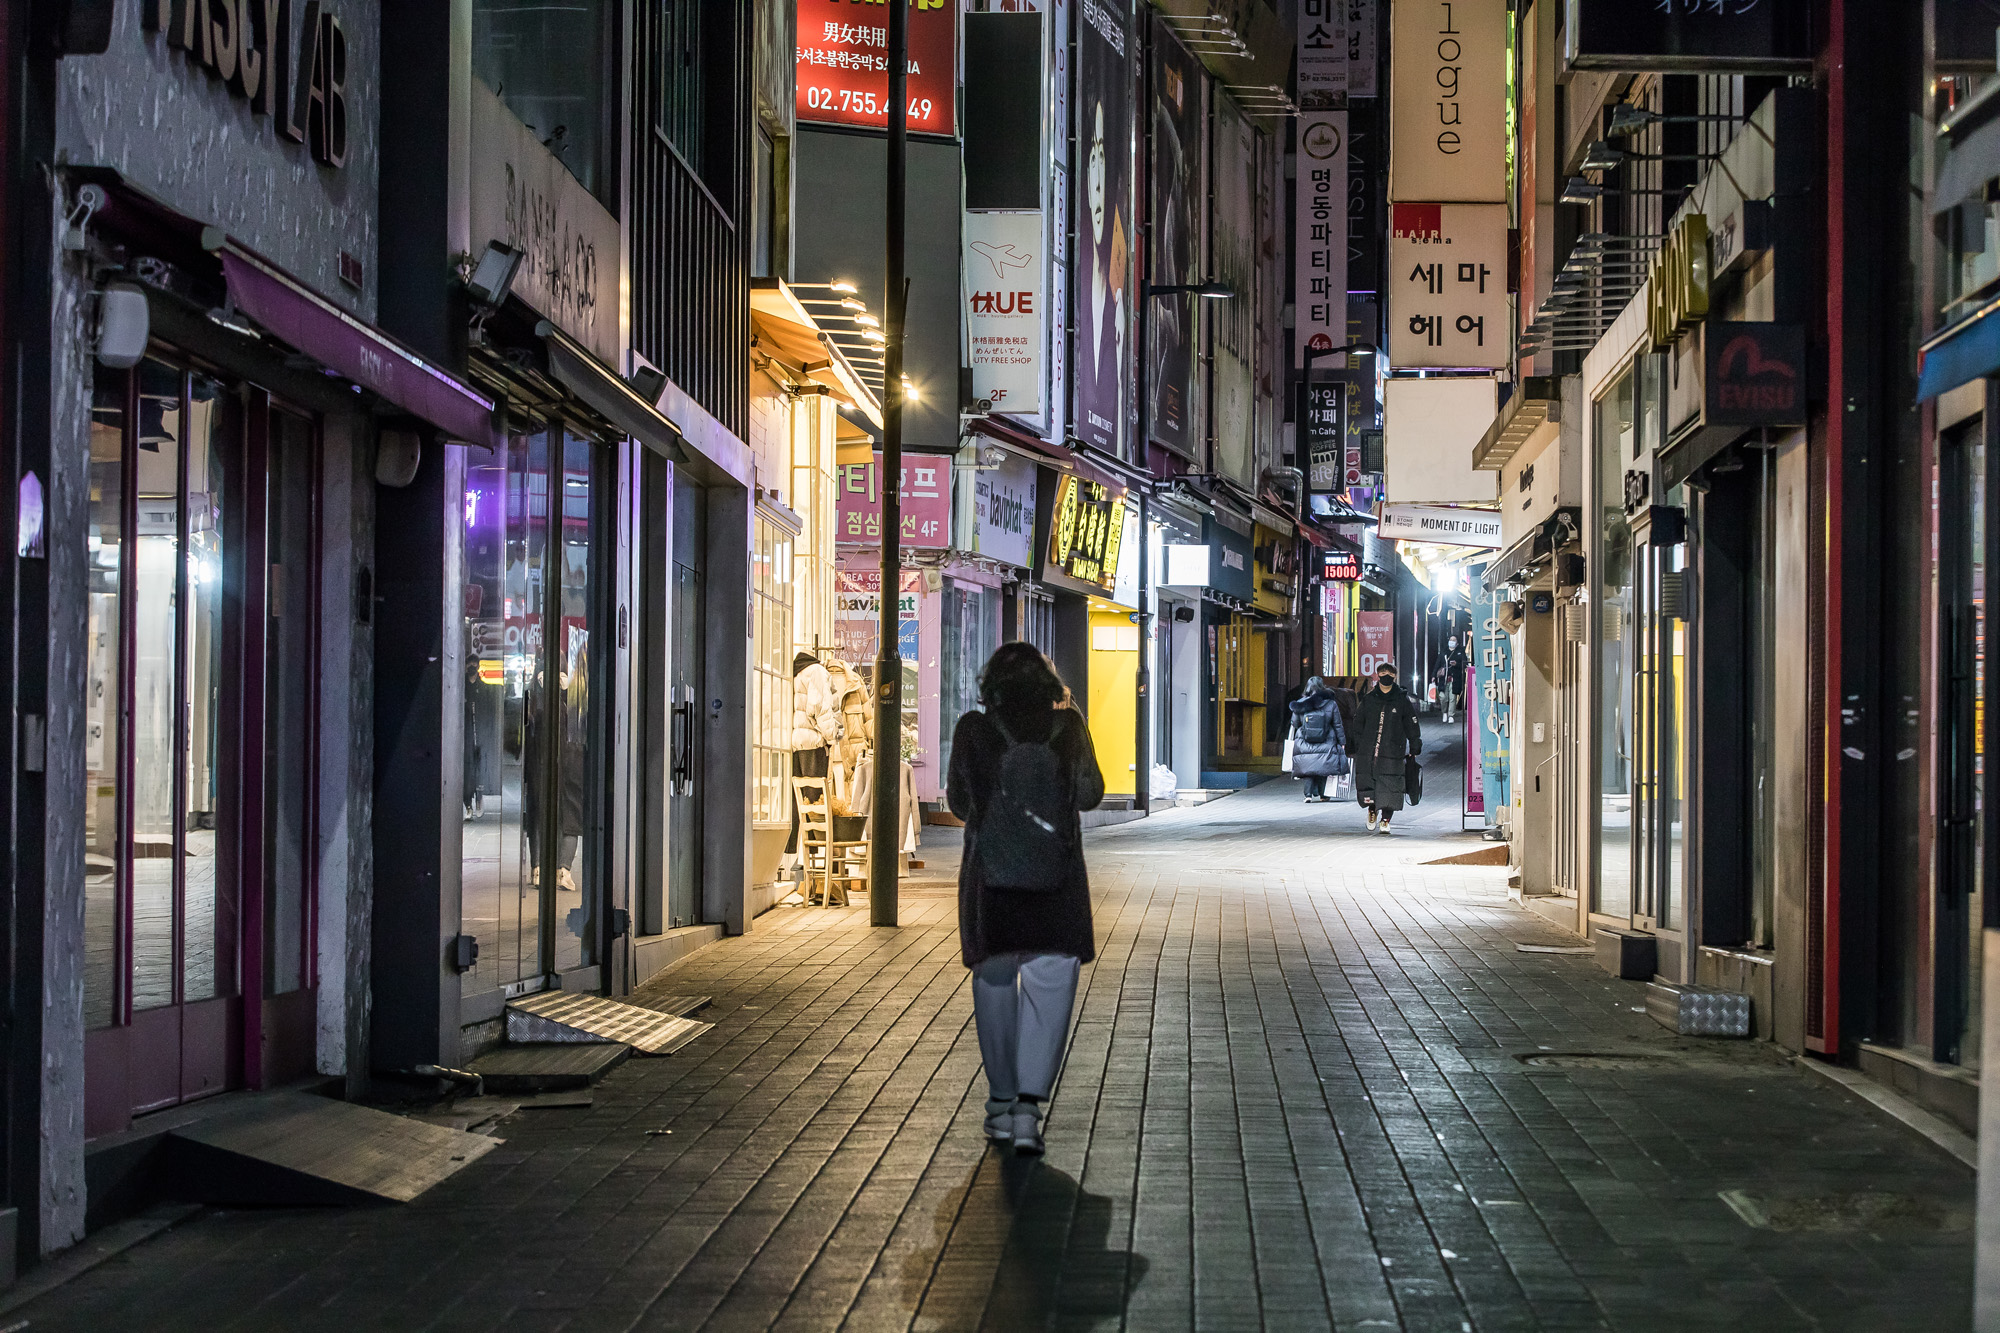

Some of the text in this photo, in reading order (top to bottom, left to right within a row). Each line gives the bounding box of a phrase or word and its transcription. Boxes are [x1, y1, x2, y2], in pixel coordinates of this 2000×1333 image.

[823, 21, 886, 48] 男女共用
[1058, 48, 1066, 149] DUTY
[1347, 133, 1365, 262] MISSHA
[1395, 229, 1439, 239] HAIR
[1411, 236, 1452, 245] sema
[990, 389, 1008, 402] 2F
[1318, 427, 1336, 436] Cafe
[990, 481, 1023, 535] baviphat
[921, 520, 939, 538] 4F
[1421, 518, 1500, 535] MOMENT OF LIGHT
[1325, 565, 1357, 578] 15000
